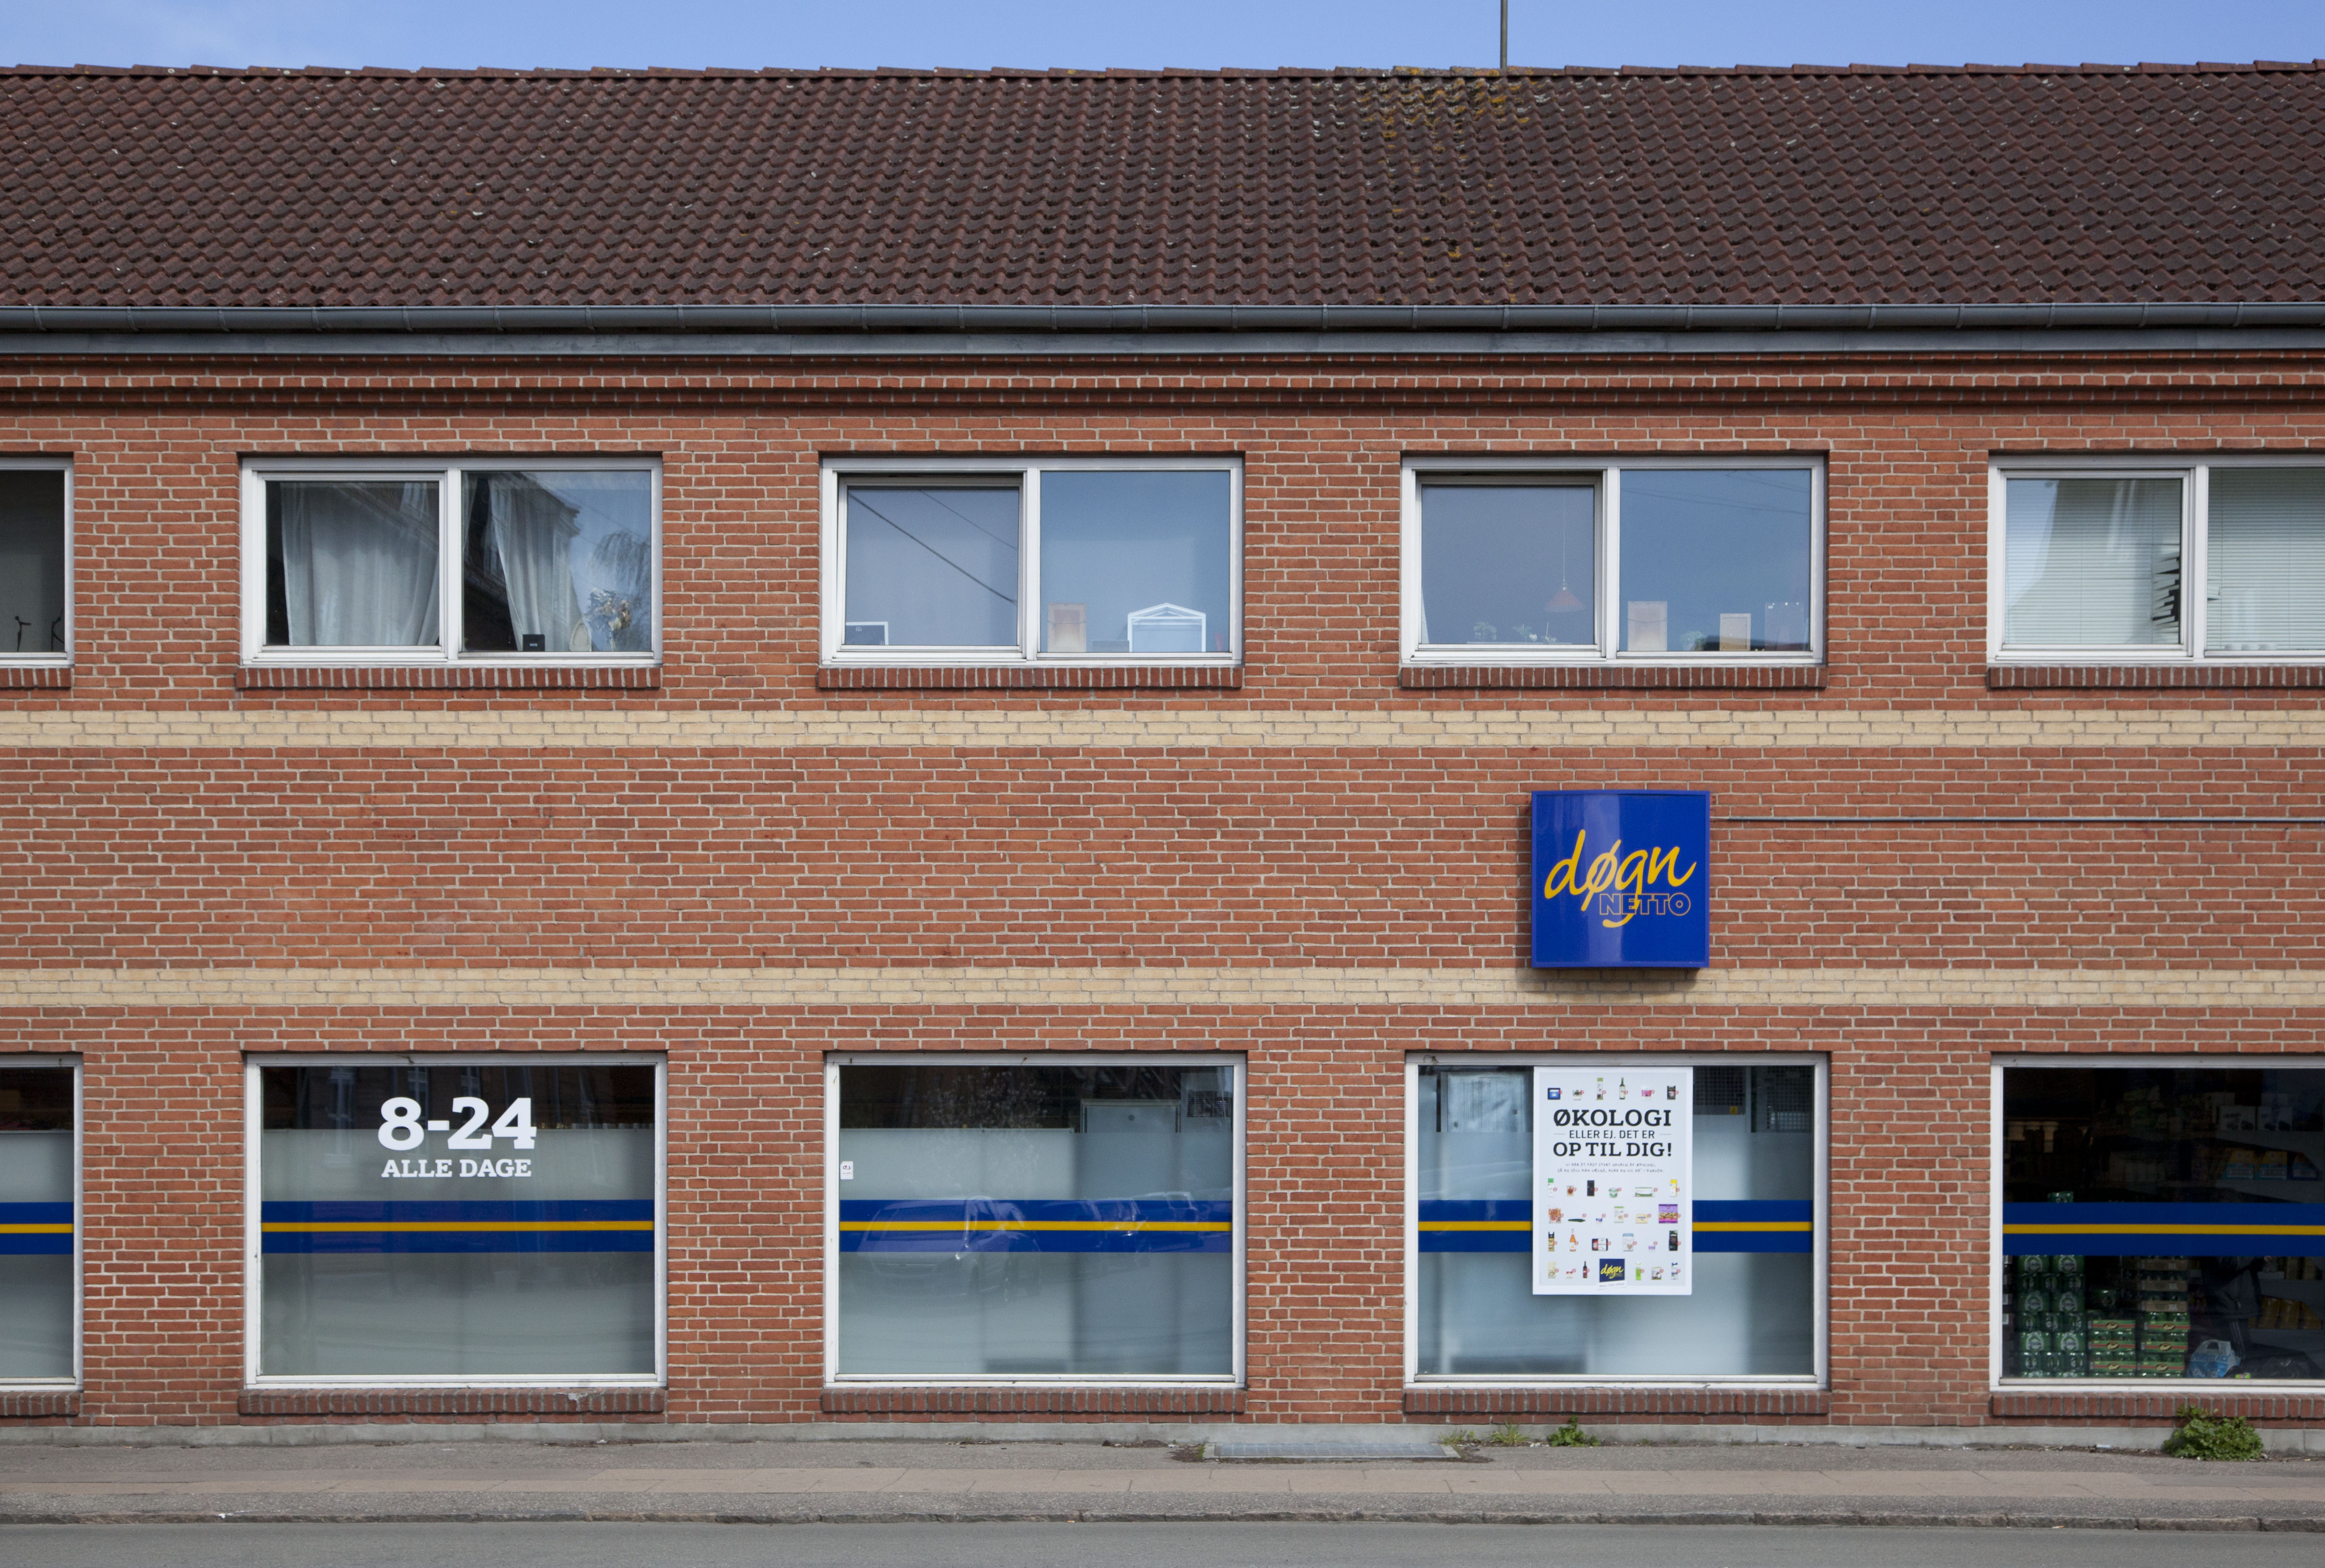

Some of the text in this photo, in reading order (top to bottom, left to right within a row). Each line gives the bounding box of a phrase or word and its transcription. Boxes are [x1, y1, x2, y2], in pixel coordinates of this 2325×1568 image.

[1544, 829, 1697, 928] døgn
[1599, 892, 1691, 916] NETTO
[378, 1097, 537, 1151] 8-24
[1553, 1109, 1672, 1126] ØKOLOGI
[1569, 1130, 1655, 1139] ELLER EJ. DET ER
[1553, 1142, 1672, 1157] OP TIL DIG!
[381, 1159, 531, 1177] ALLE DAGE
[1601, 1263, 1624, 1279] døgn
